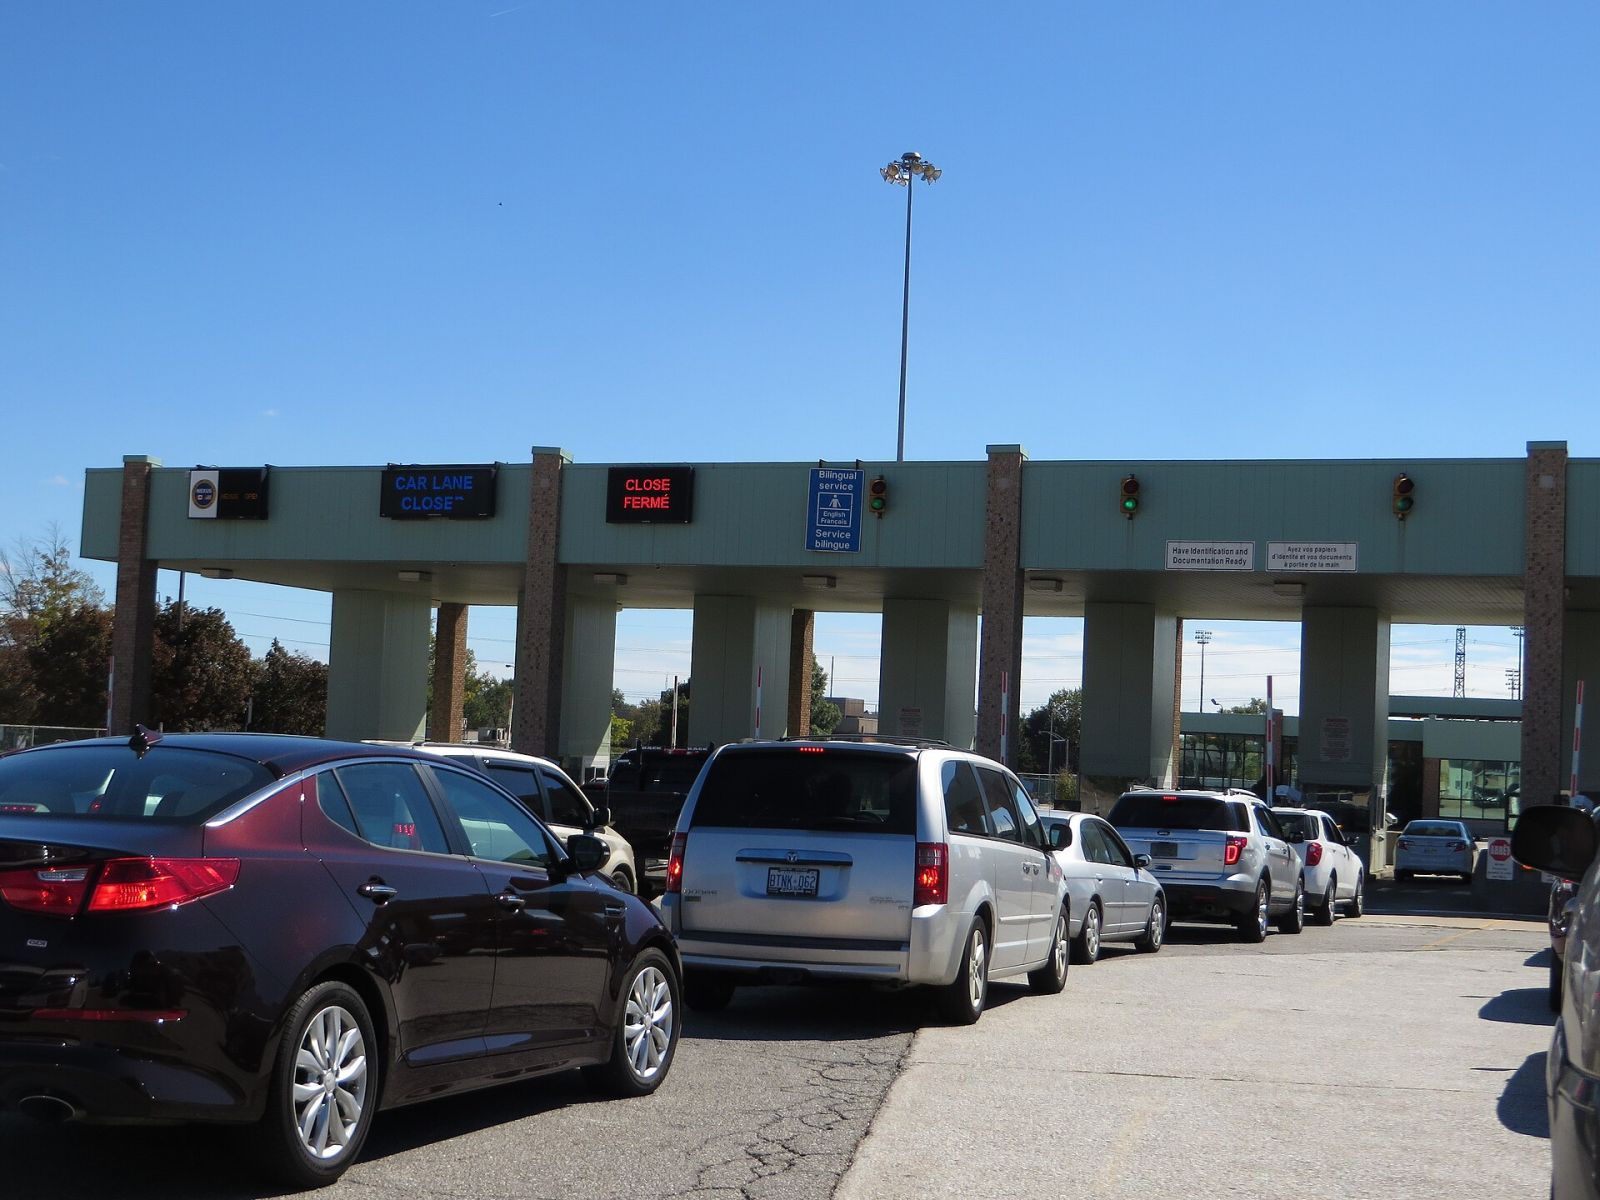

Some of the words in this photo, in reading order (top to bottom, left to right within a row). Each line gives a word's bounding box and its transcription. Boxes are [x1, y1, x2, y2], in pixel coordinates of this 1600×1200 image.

[818, 470, 857, 481] Bilingual
[395, 475, 427, 490] CAR
[432, 475, 473, 490] LANE
[625, 478, 671, 491] CLOSE
[819, 482, 854, 490] service
[401, 495, 464, 510] CLOSE
[623, 493, 670, 509] FERMÉ
[823, 511, 846, 519] English
[815, 529, 851, 539] Service
[815, 540, 850, 551] bilingue
[1172, 547, 1189, 555] Have
[1190, 547, 1234, 555] Identification
[1235, 548, 1248, 556] and
[1172, 556, 1224, 565] Documentation
[1225, 557, 1247, 566] Ready
[769, 874, 792, 888] BTNK
[798, 875, 816, 889] 062
